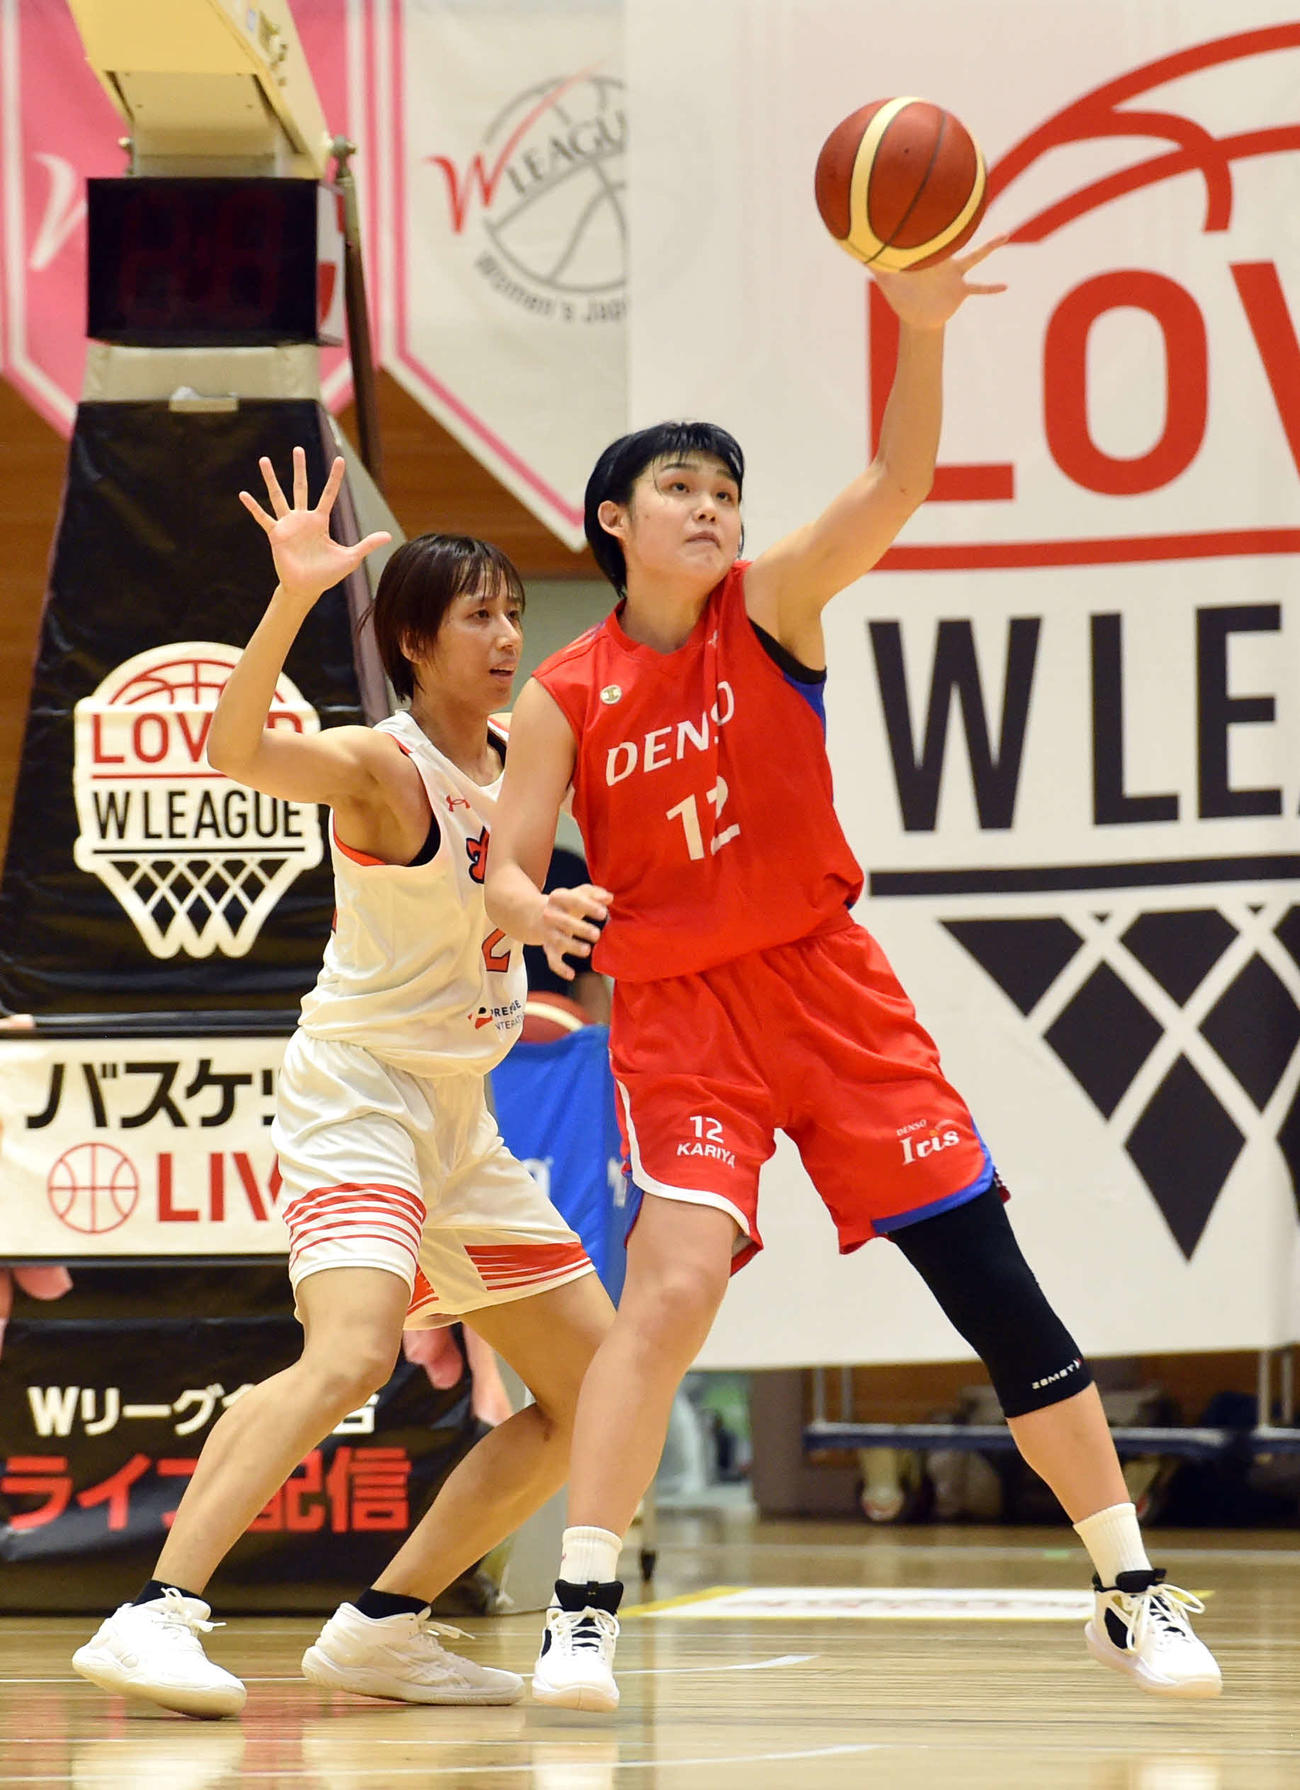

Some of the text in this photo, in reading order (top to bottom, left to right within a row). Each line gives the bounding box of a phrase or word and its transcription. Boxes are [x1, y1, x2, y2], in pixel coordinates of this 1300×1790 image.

[507, 108, 627, 193] LEAGU
[605, 681, 734, 787] DENO
[867, 603, 1300, 832] W LE
[92, 790, 304, 840] W LEAGUE
[666, 775, 741, 861] 12
[677, 1142, 736, 1169] KARIYA
[690, 1115, 724, 1144] 12
[900, 1129, 960, 1166] Iris
